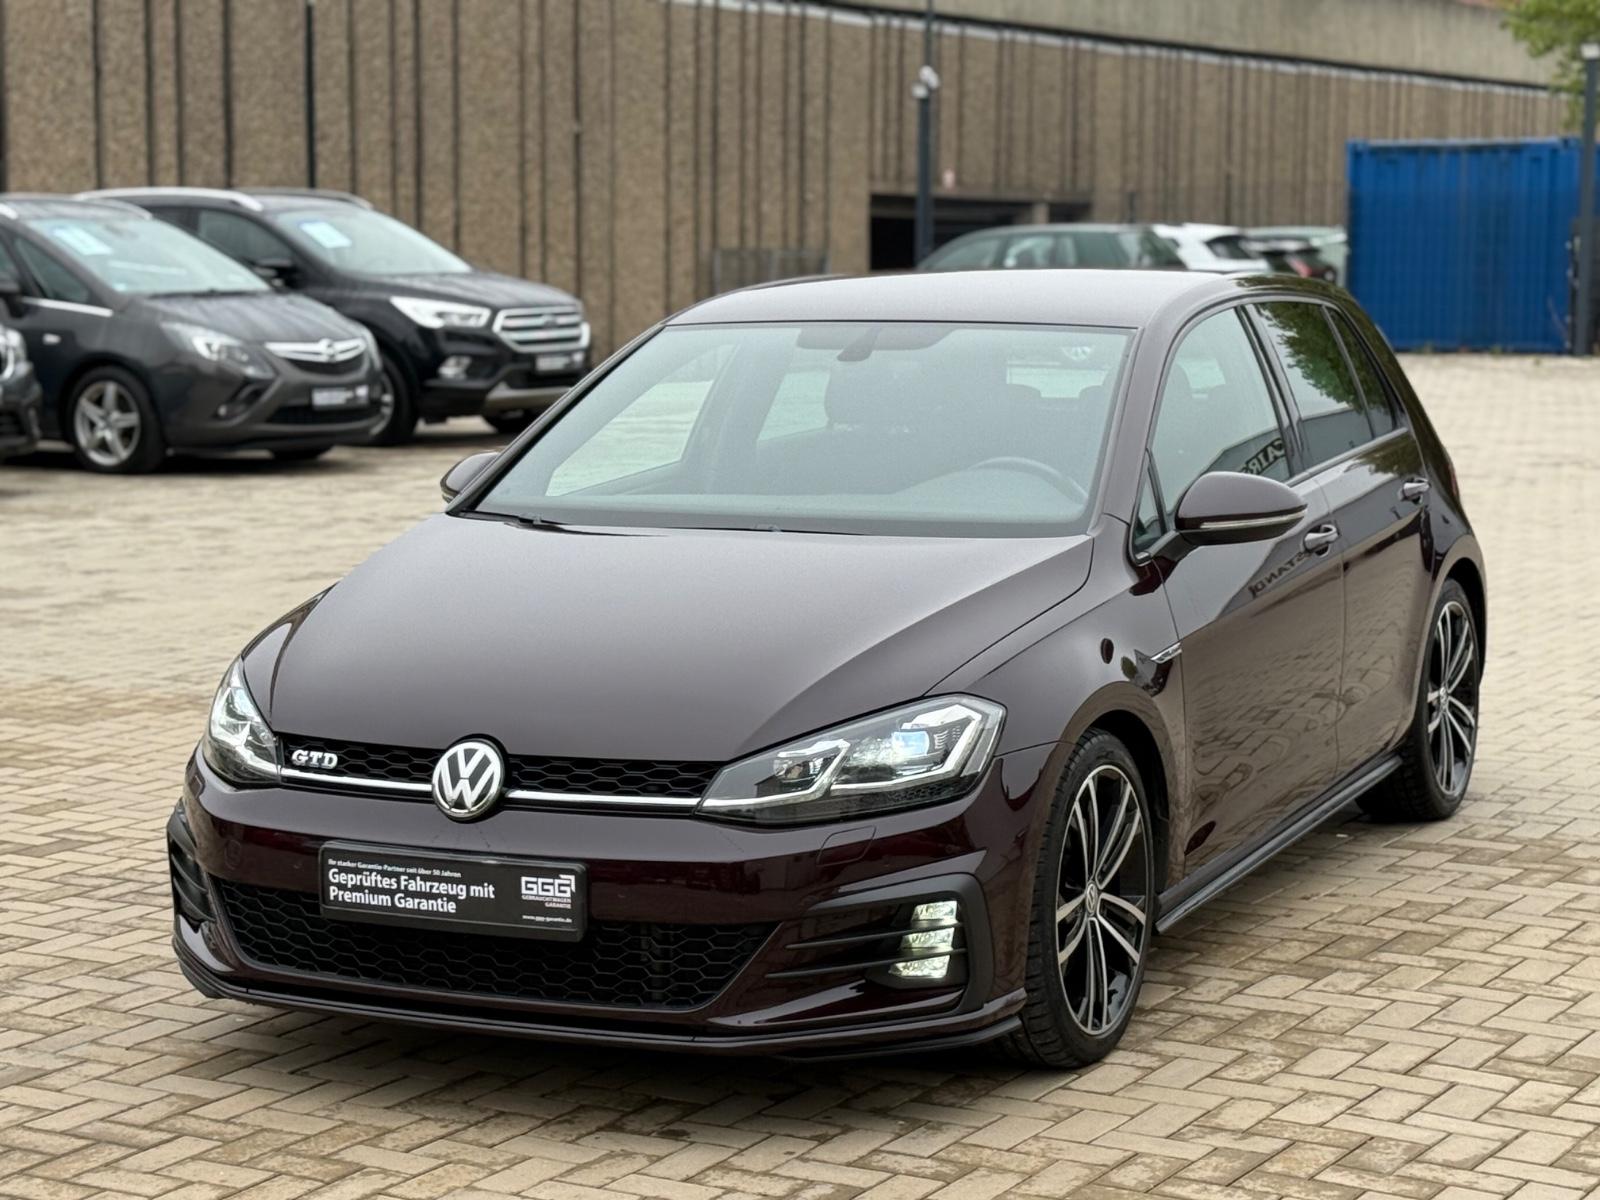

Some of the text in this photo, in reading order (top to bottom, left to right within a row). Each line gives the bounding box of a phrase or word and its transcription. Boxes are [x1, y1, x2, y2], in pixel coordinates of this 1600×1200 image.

[291, 749, 338, 770] GTD
[436, 742, 501, 814] VW
[328, 868, 496, 900] Geprüftes Fahrzeug mit
[520, 875, 573, 898] GGG
[329, 885, 457, 913] Premium Garantie
